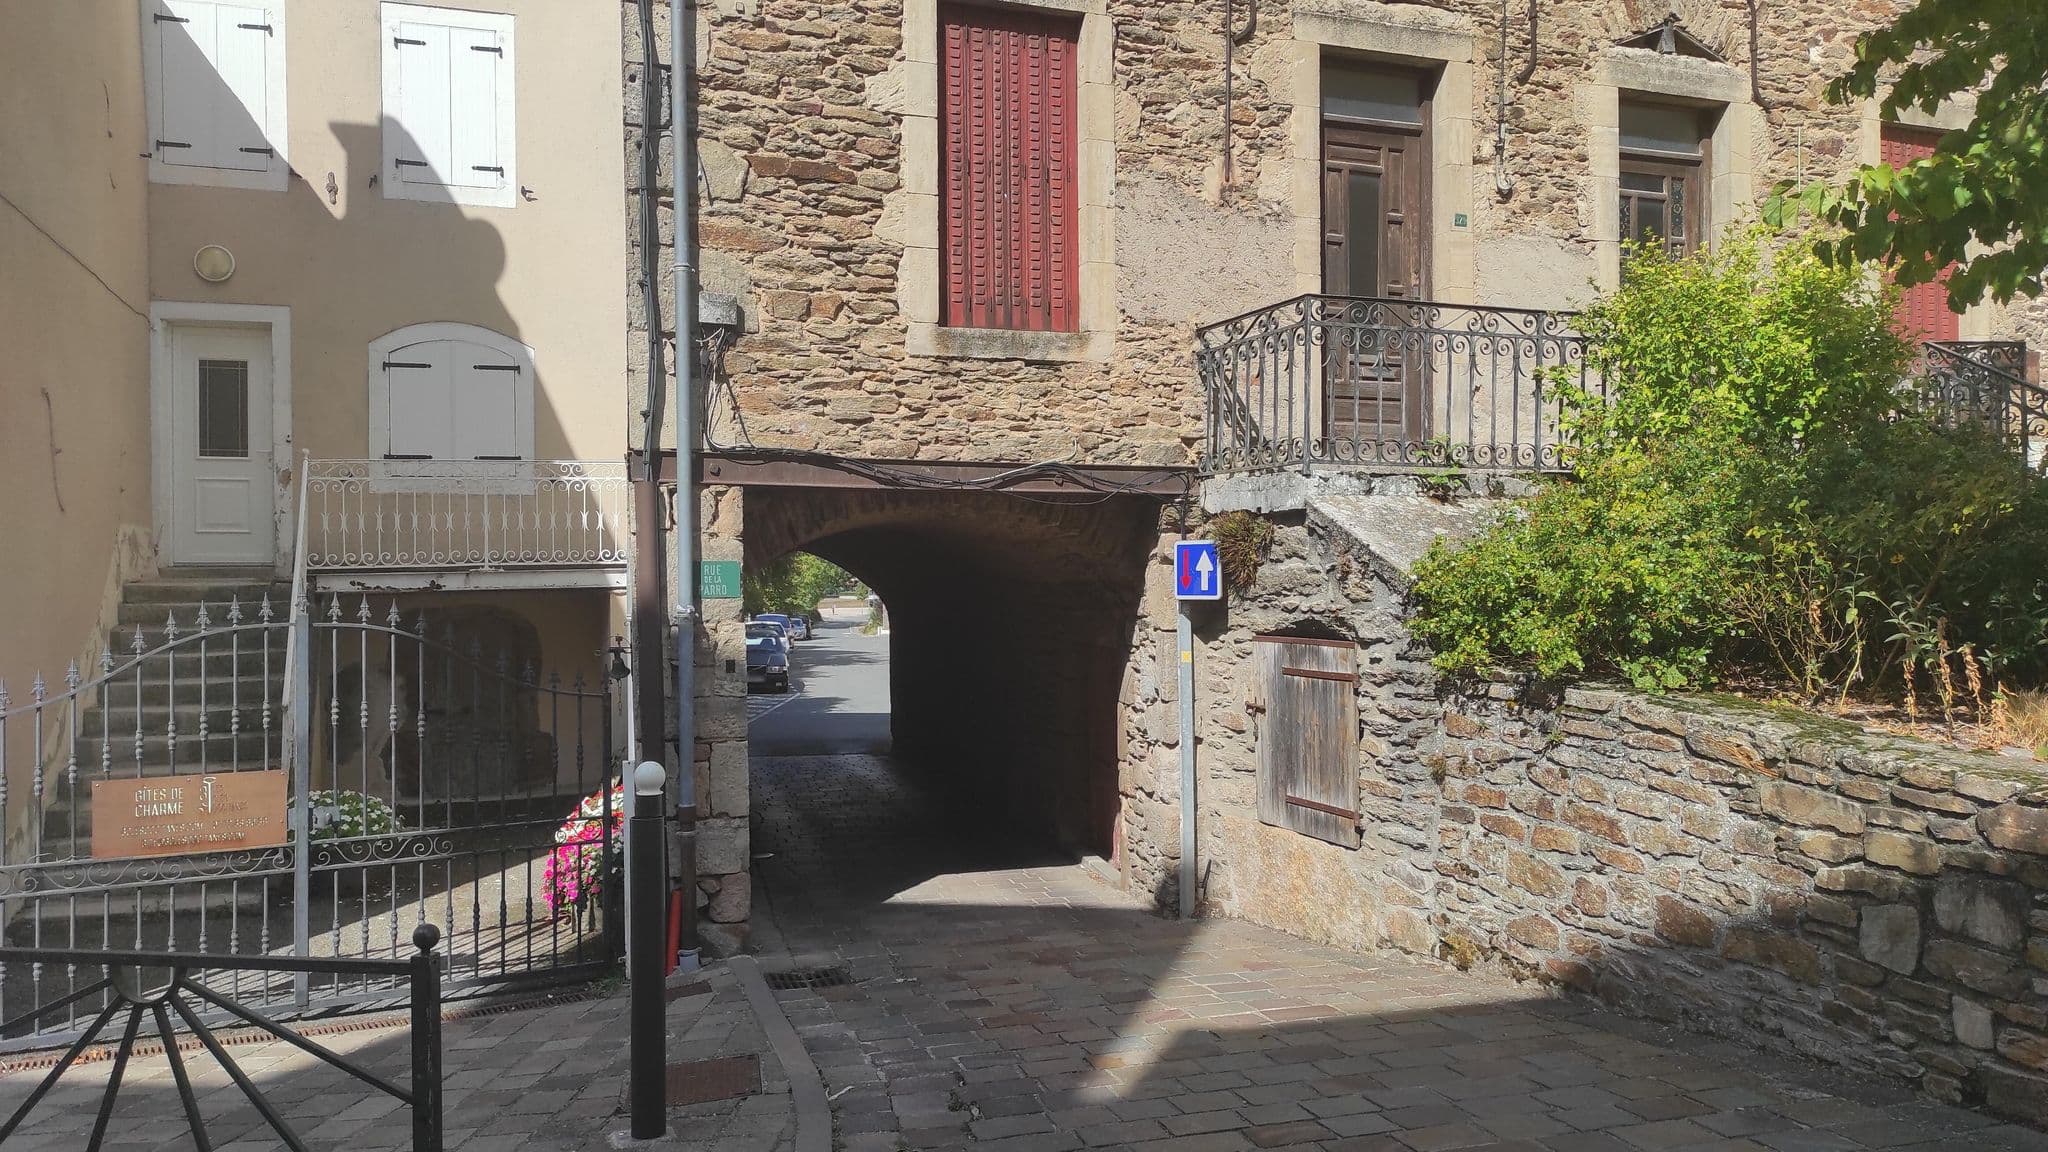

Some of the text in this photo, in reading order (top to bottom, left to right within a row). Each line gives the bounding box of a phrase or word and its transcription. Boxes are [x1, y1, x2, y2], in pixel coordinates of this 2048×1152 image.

[704, 565, 722, 575] RUE
[135, 786, 184, 802] GÎTES DE
[135, 801, 184, 817] CHARME
